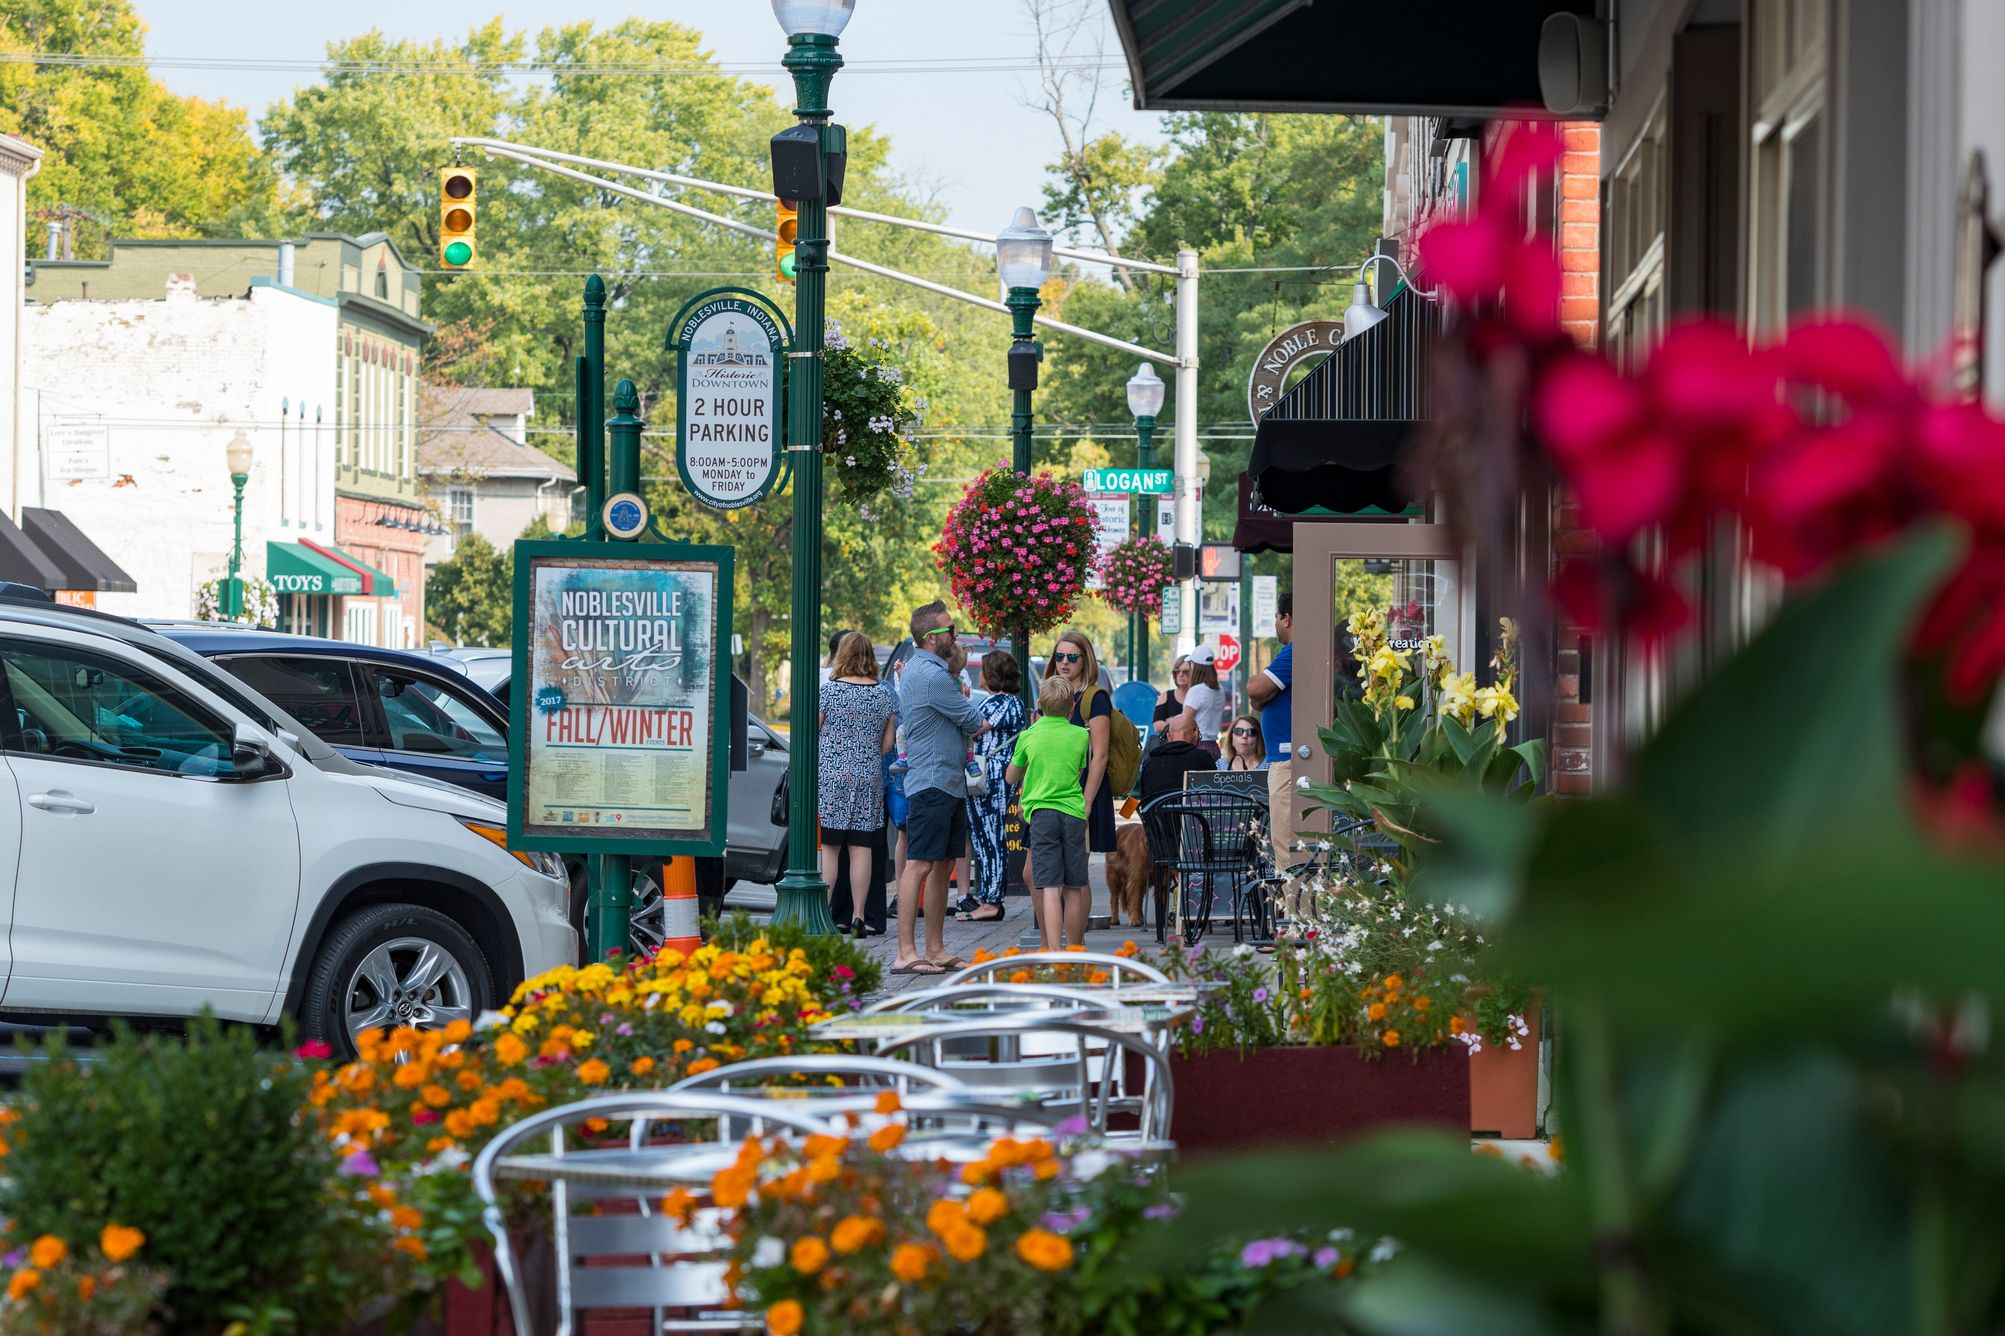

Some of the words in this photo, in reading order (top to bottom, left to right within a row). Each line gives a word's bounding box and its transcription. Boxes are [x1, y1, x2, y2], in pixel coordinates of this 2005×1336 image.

[746, 304, 779, 343] INDIANA
[1263, 328, 1319, 376] NOBLE
[703, 368, 756, 380] Historic
[692, 378, 768, 389] DOWNTOWN
[694, 398, 705, 417] 2
[713, 398, 764, 417] HOUR
[690, 423, 769, 442] PARKING
[702, 469, 742, 480] MONDAY
[746, 469, 756, 480] to
[1096, 473, 1154, 491] LOGAN
[1155, 472, 1168, 485] ST
[712, 481, 745, 492] FRIDAY
[274, 575, 323, 591] TOYS
[562, 591, 682, 617] NOBLESVILLE
[562, 619, 682, 651] CULTURAL
[560, 643, 682, 672] arts
[1219, 644, 1239, 660] OP
[573, 675, 671, 688] DISTRICT
[540, 695, 562, 707] 2017
[546, 707, 693, 747] FALL/WINTER
[1213, 772, 1253, 787] Specials
